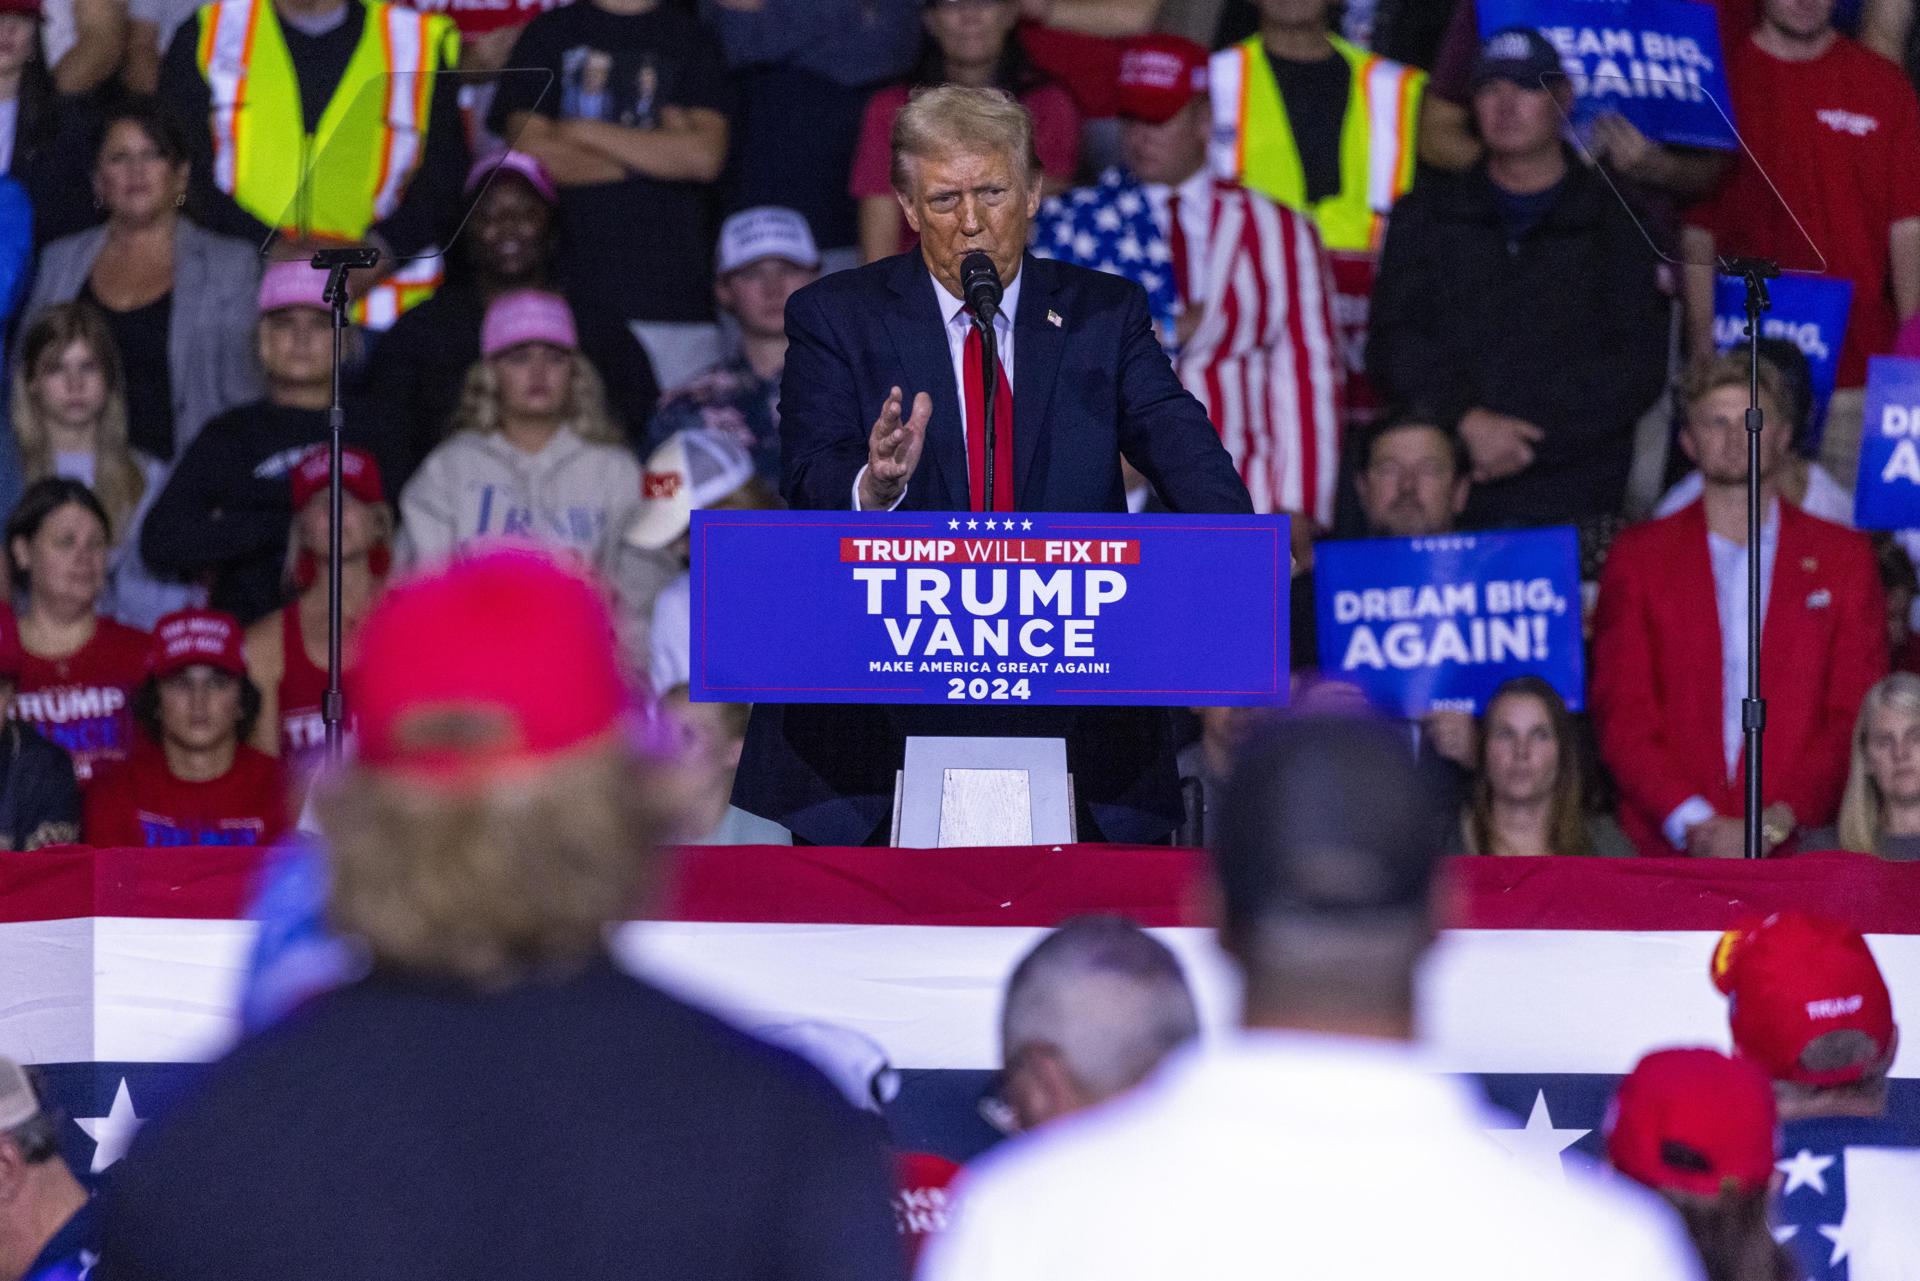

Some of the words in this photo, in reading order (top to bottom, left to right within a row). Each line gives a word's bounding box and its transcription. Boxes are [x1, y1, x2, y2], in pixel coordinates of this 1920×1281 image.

[1539, 26, 1634, 54] EAM
[1641, 31, 1714, 73] BIG,
[853, 539, 956, 562] TRUMP
[964, 540, 1036, 562] WILL
[1045, 541, 1092, 563] FIX
[1100, 541, 1128, 563] IT
[853, 568, 1127, 616] TRUMP
[1334, 580, 1477, 624] DREAM
[1485, 577, 1567, 616] BIG,
[883, 618, 1095, 657] VANCE
[1343, 614, 1549, 670] AGAIN!
[869, 661, 914, 672] MAKE
[919, 661, 991, 673] AMERICA
[997, 662, 1049, 673] GREAT
[1054, 663, 1111, 674] AGAIN!
[947, 677, 1031, 700] 2024
